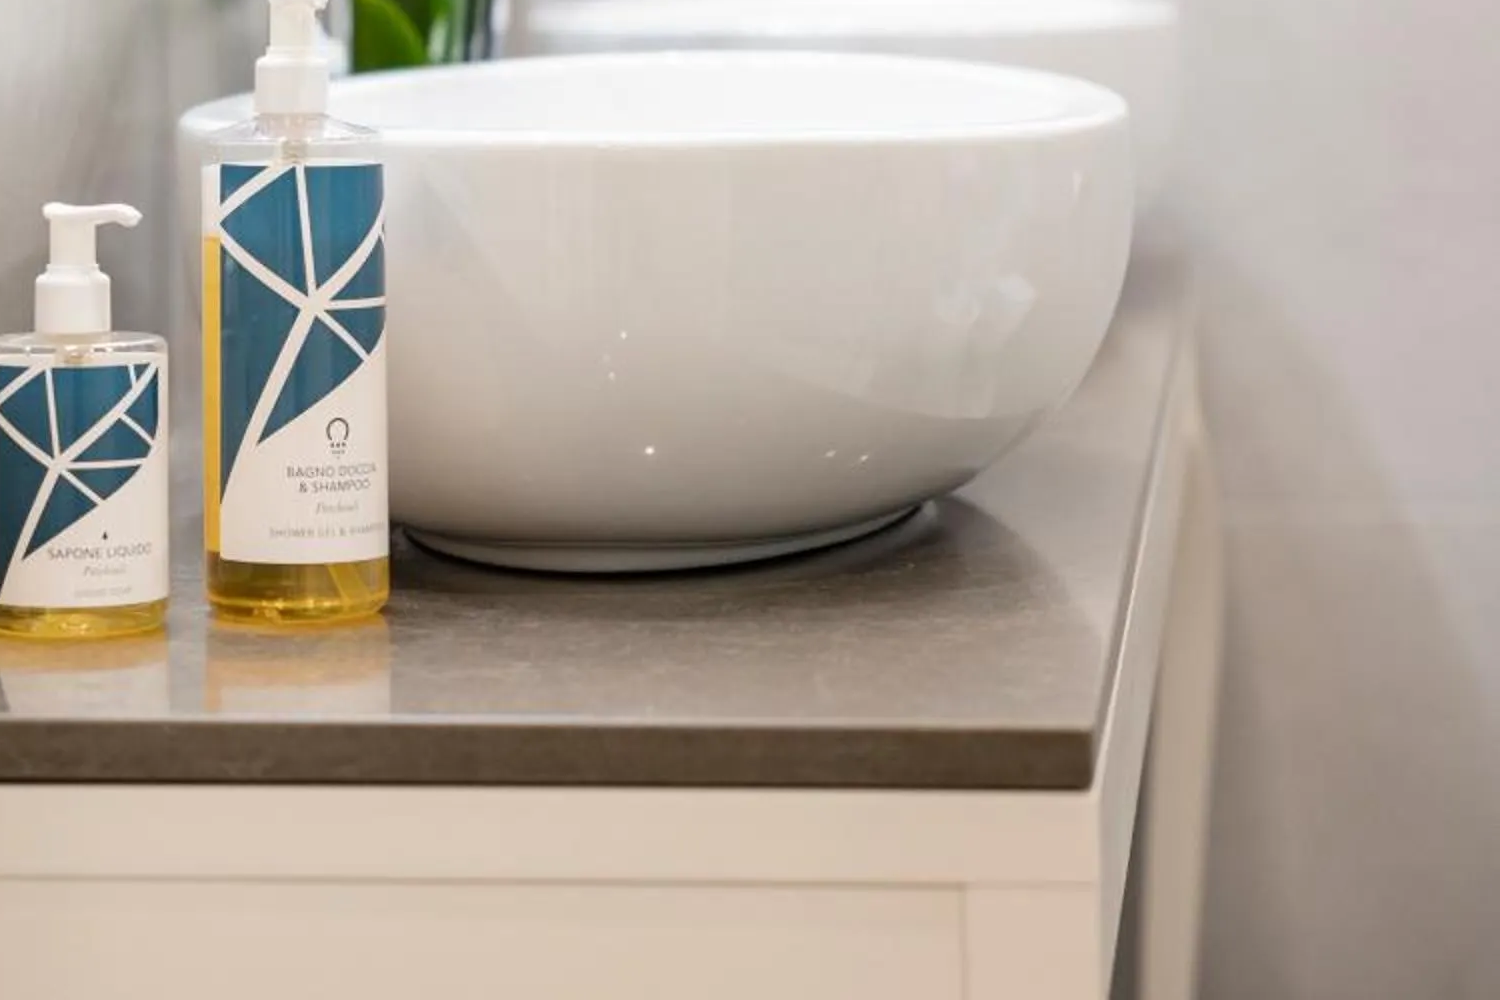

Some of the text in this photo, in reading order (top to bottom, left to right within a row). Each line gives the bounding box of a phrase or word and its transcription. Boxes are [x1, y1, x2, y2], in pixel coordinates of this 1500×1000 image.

[286, 465, 335, 478] BAGNO
[311, 478, 371, 493] SHAMPOO
[47, 546, 102, 560] SAPONE
